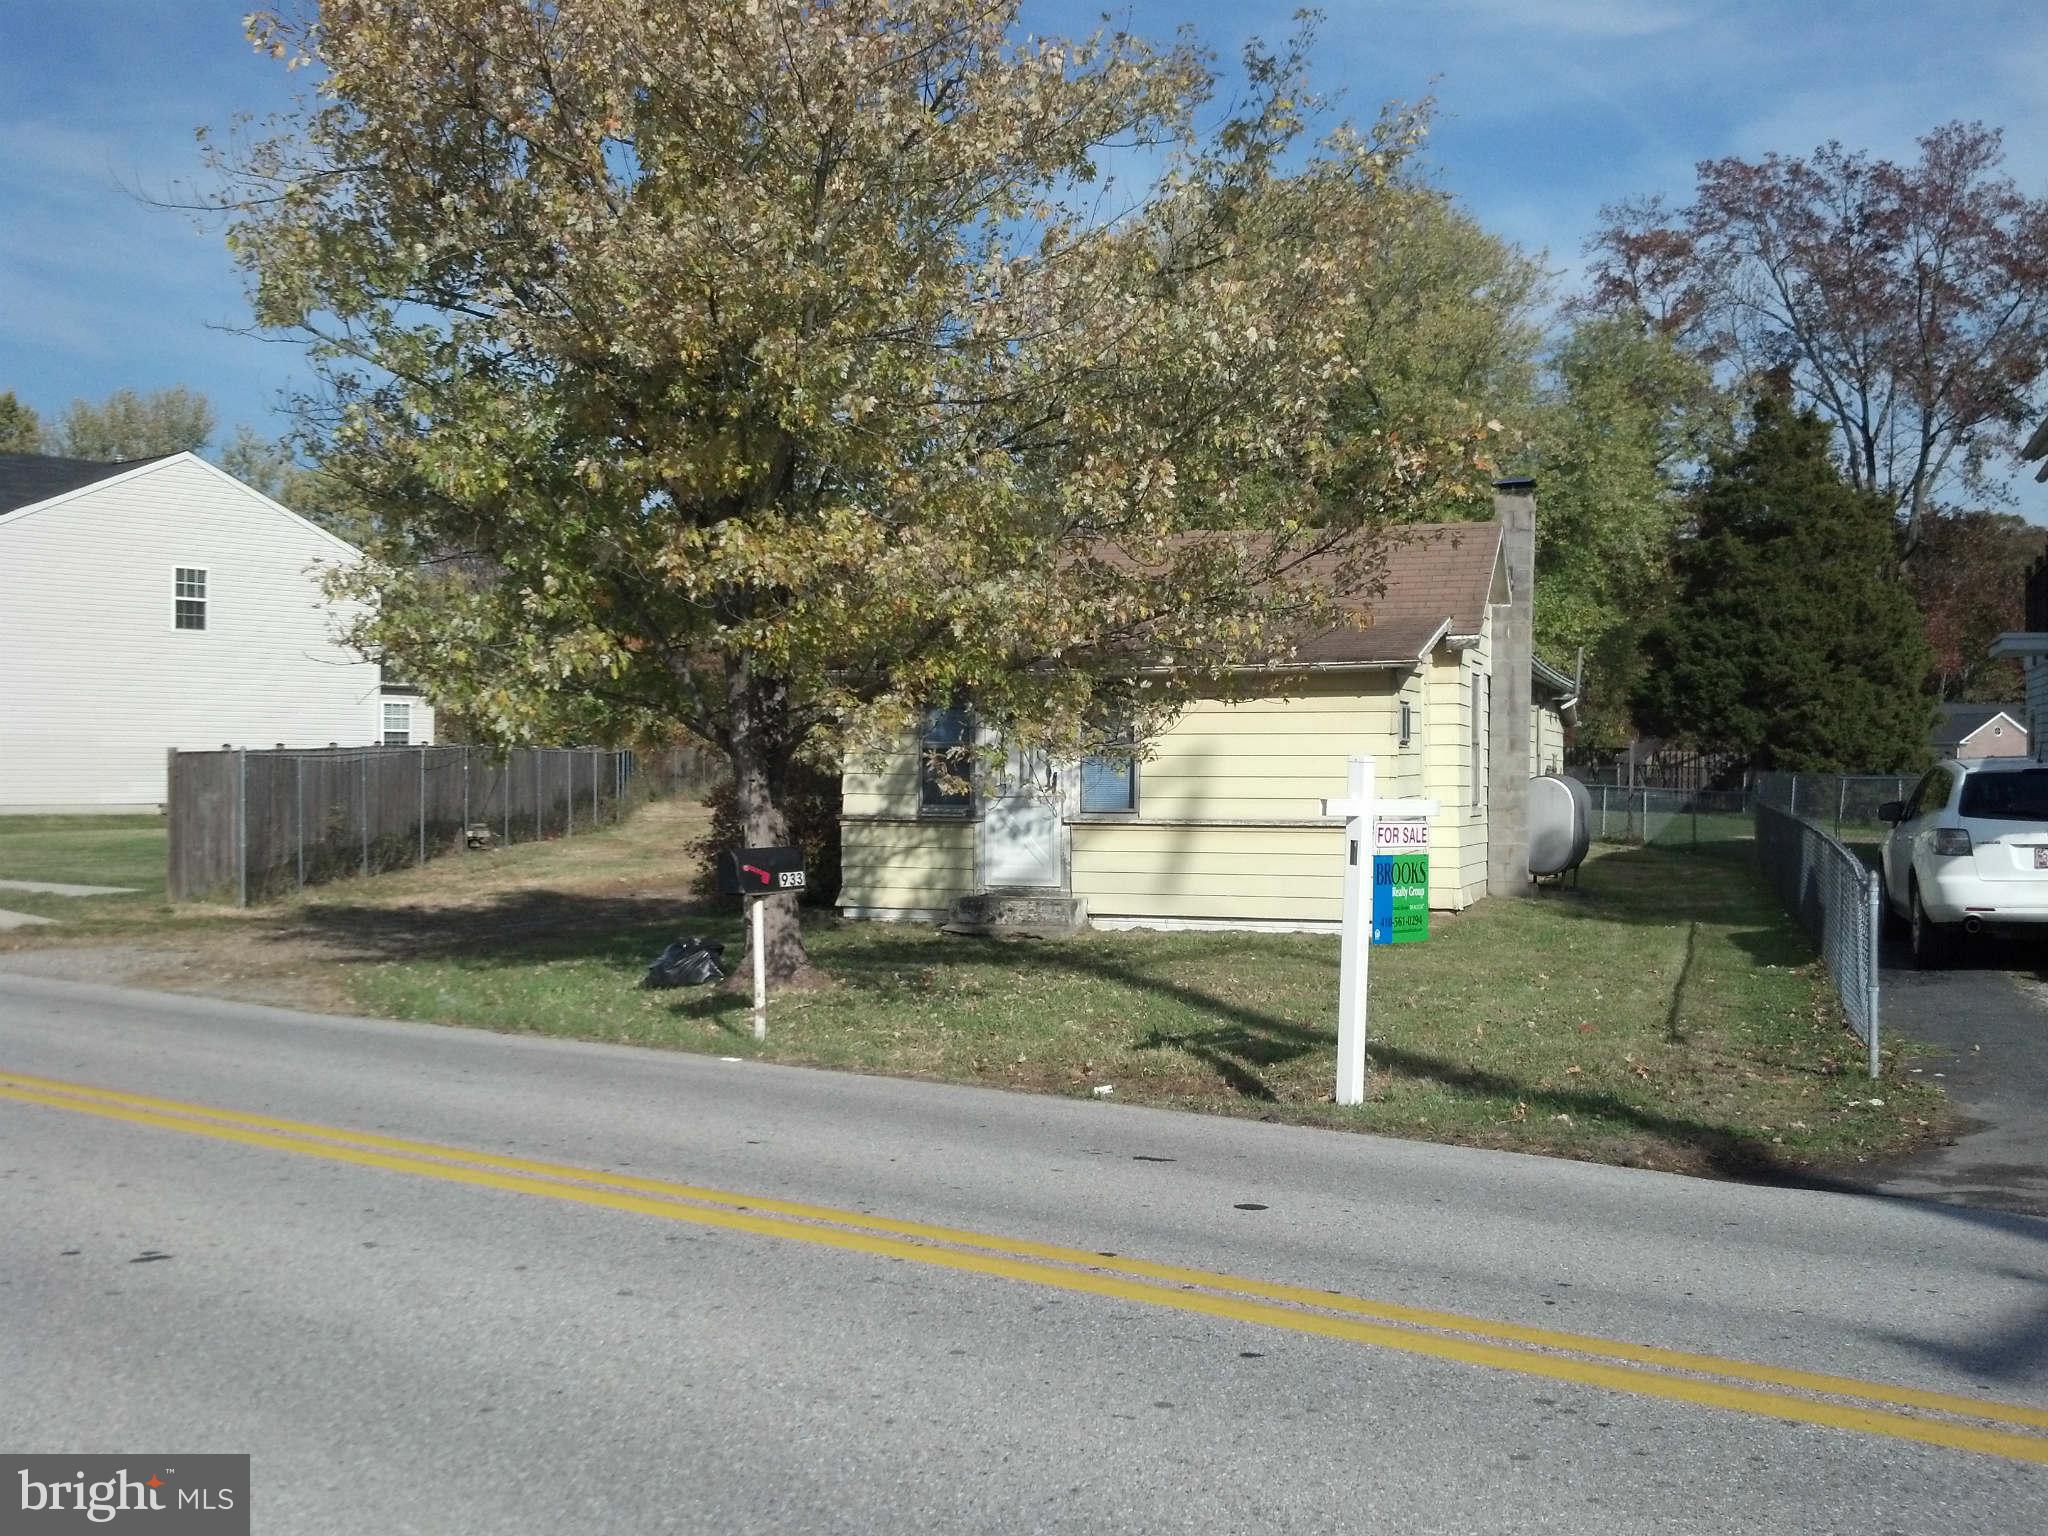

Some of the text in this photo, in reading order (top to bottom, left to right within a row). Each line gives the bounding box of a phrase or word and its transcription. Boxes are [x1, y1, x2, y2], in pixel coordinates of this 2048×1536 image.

[1377, 827, 1427, 843] FOR SALE
[781, 873, 803, 886] 933
[1376, 862, 1426, 885] BROOKS
[1408, 886, 1425, 899] Group
